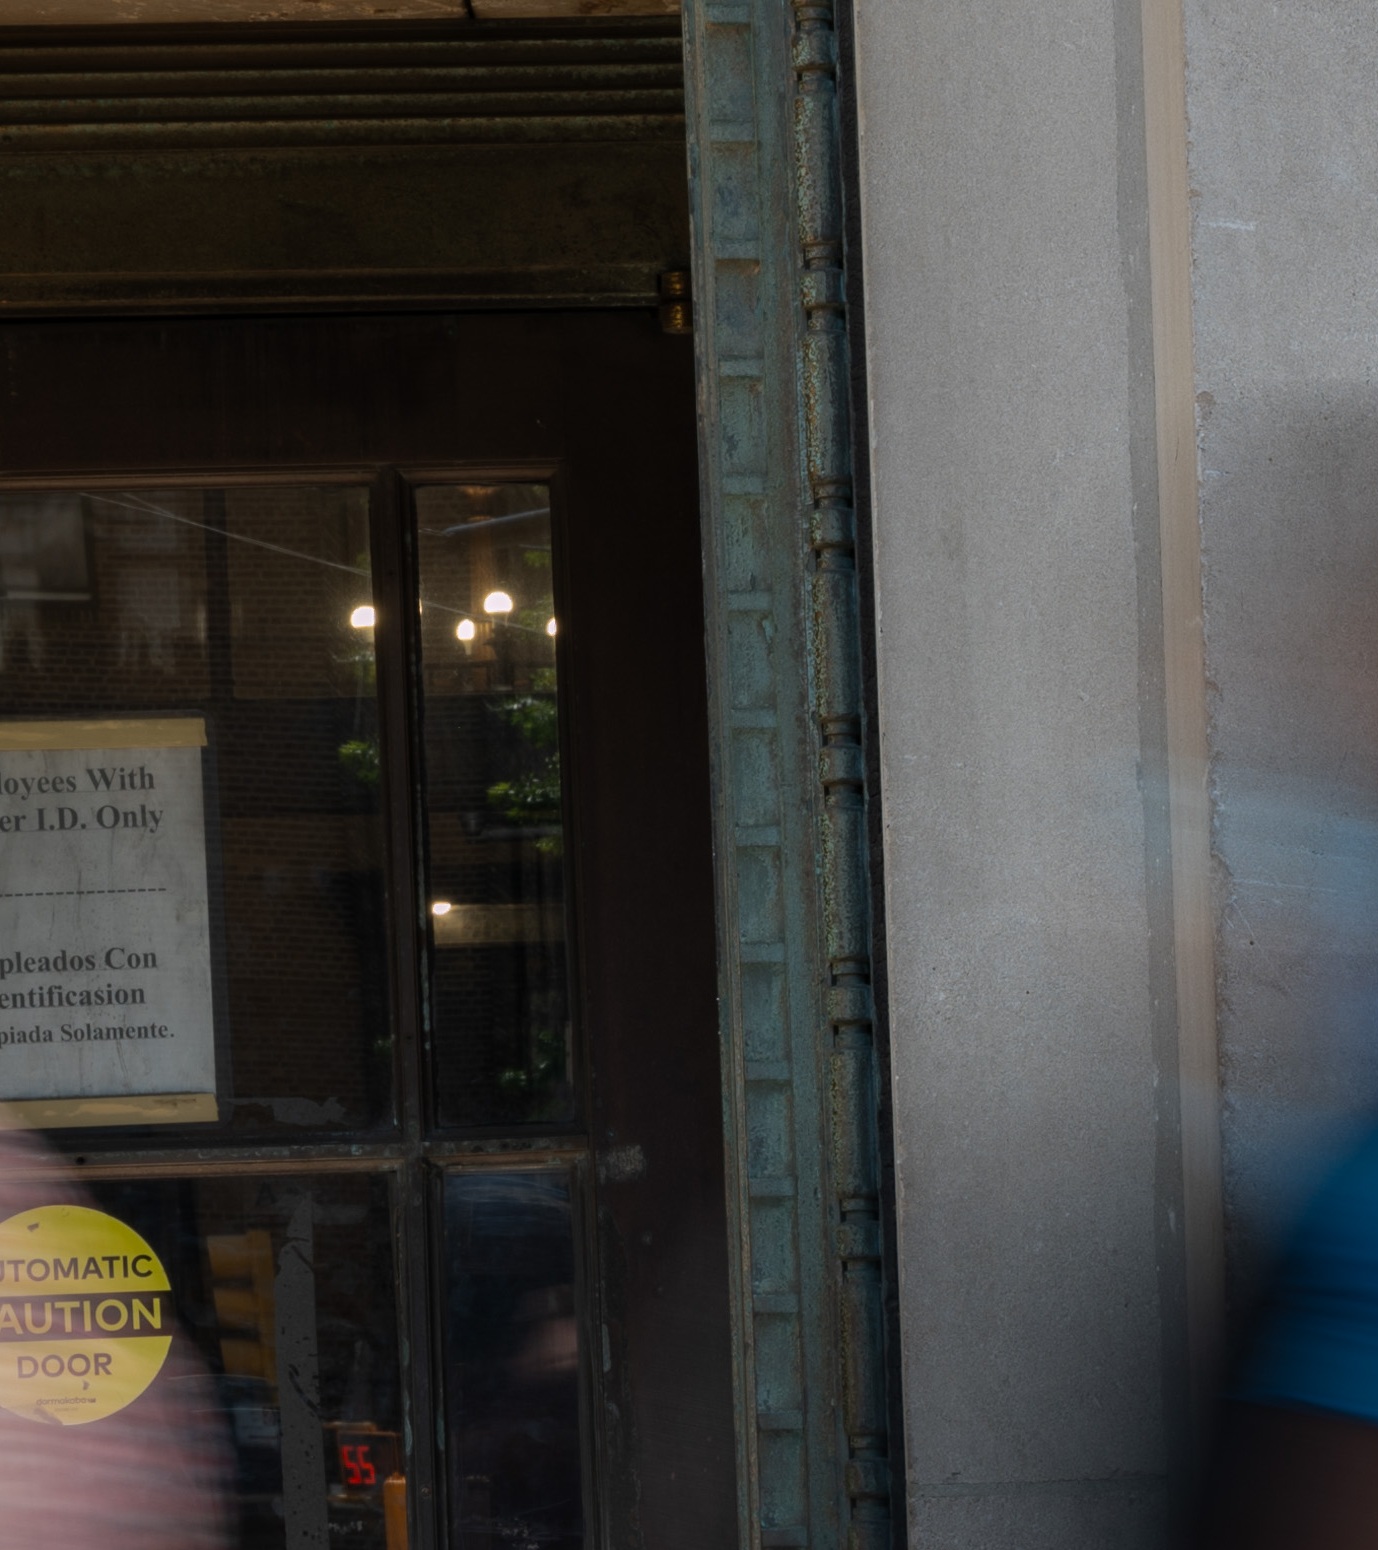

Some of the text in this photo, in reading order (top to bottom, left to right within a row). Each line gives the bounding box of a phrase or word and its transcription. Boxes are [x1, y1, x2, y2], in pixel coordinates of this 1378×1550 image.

[0, 766, 155, 801] oyees With
[36, 806, 86, 831] I.D.
[96, 804, 163, 833] Only
[104, 947, 158, 971] Con
[60, 1021, 175, 1042] Solamente.
[0, 1297, 162, 1335] AUTION
[17, 1352, 112, 1378] DOOR
